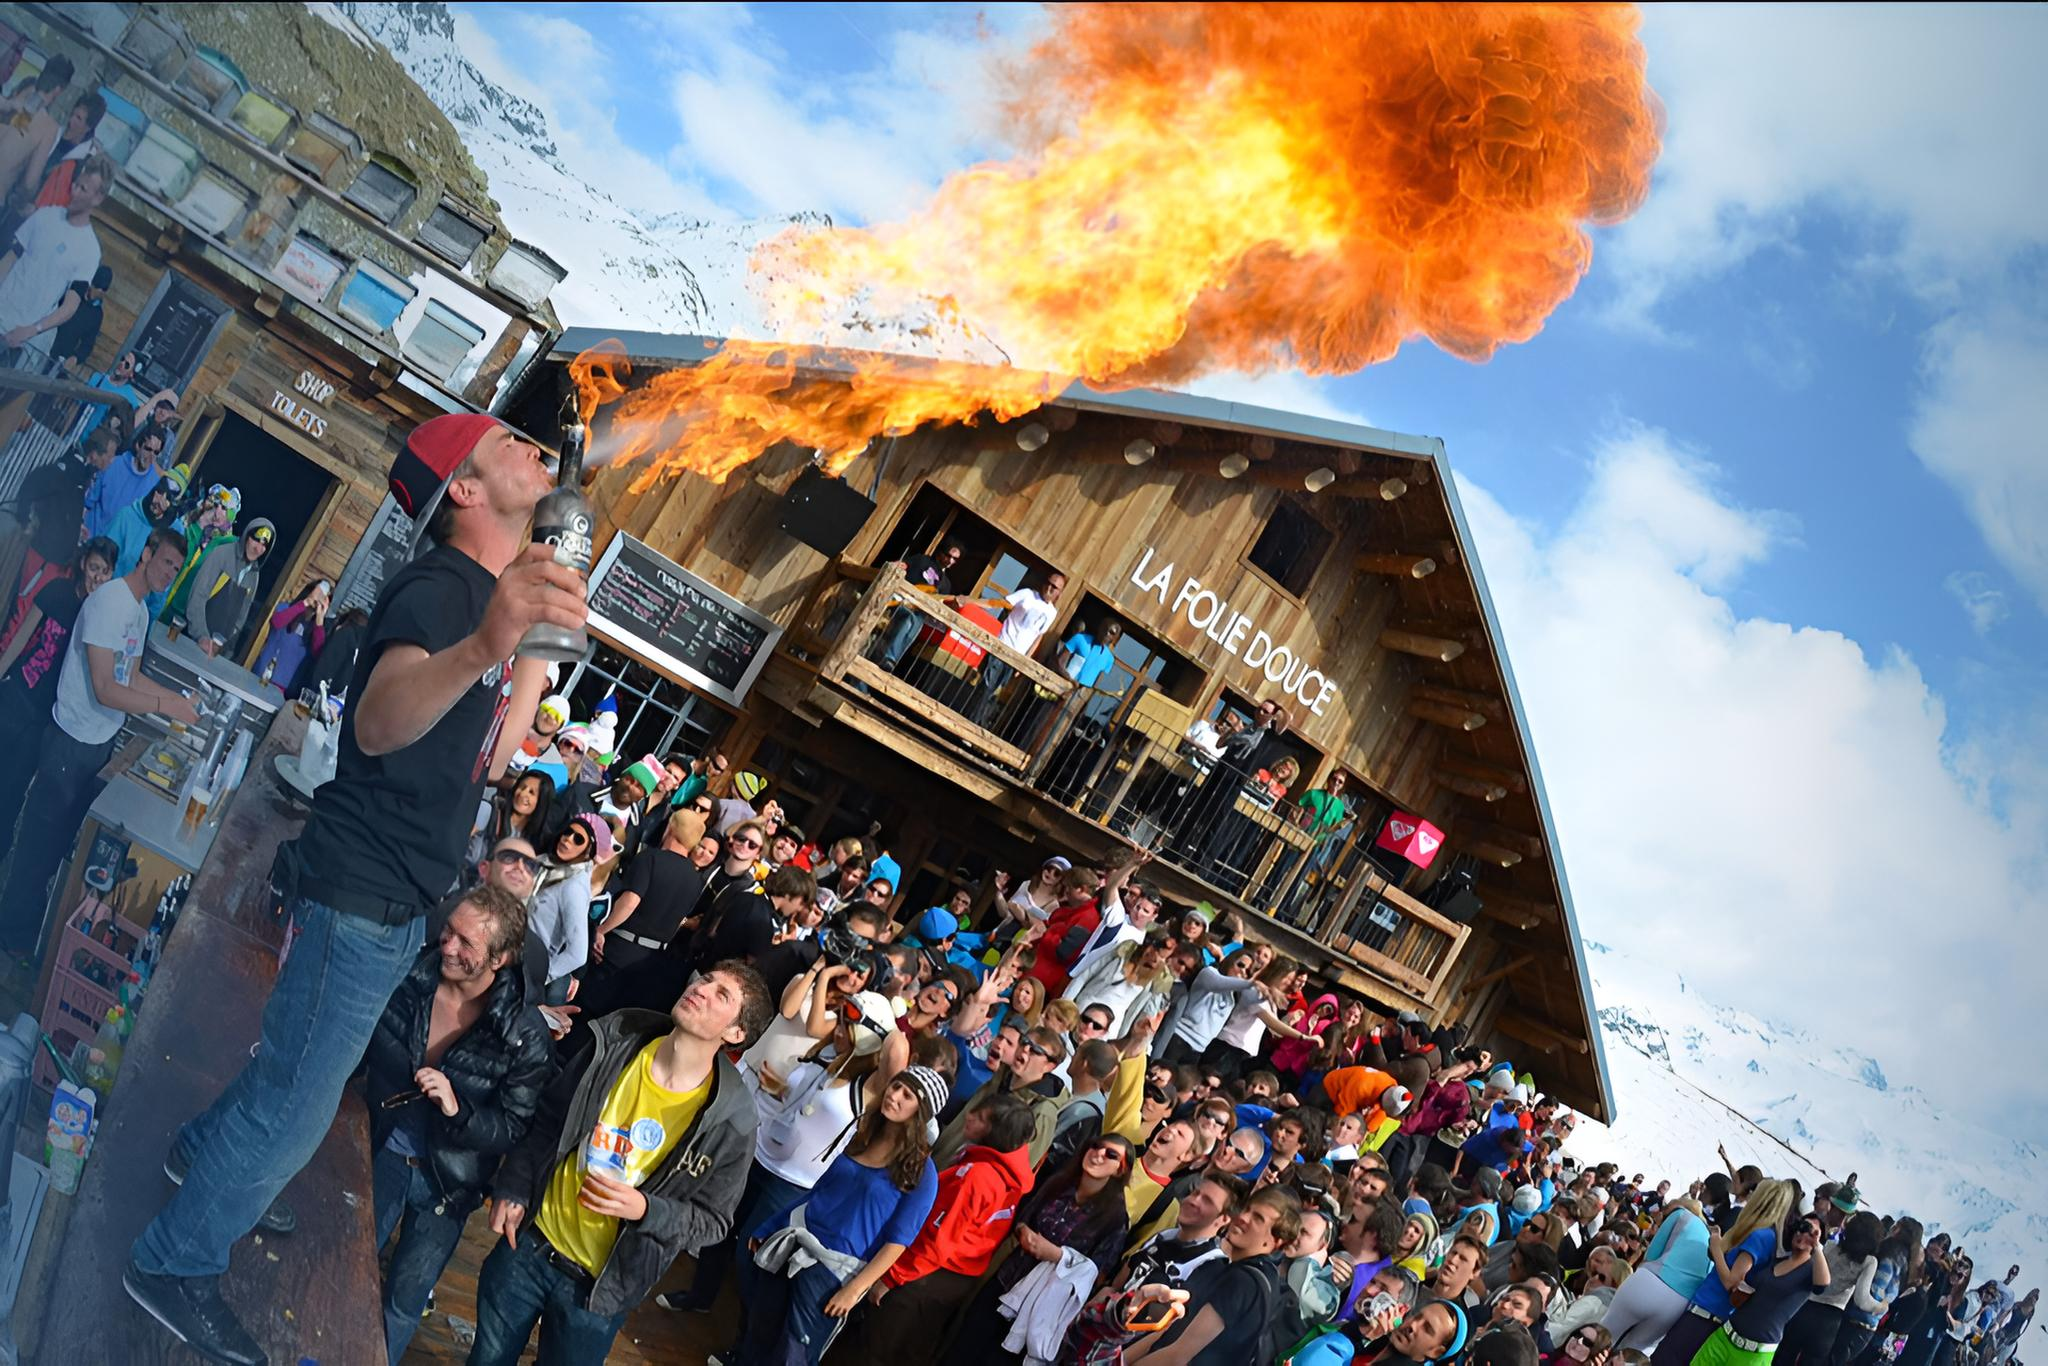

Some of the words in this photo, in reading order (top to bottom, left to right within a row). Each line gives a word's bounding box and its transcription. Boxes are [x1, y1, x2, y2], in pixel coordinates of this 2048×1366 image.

[294, 369, 337, 407] SHOP
[1130, 547, 1175, 605] LA
[1170, 576, 1253, 656] FOLIE
[1242, 629, 1338, 718] DOUCE
